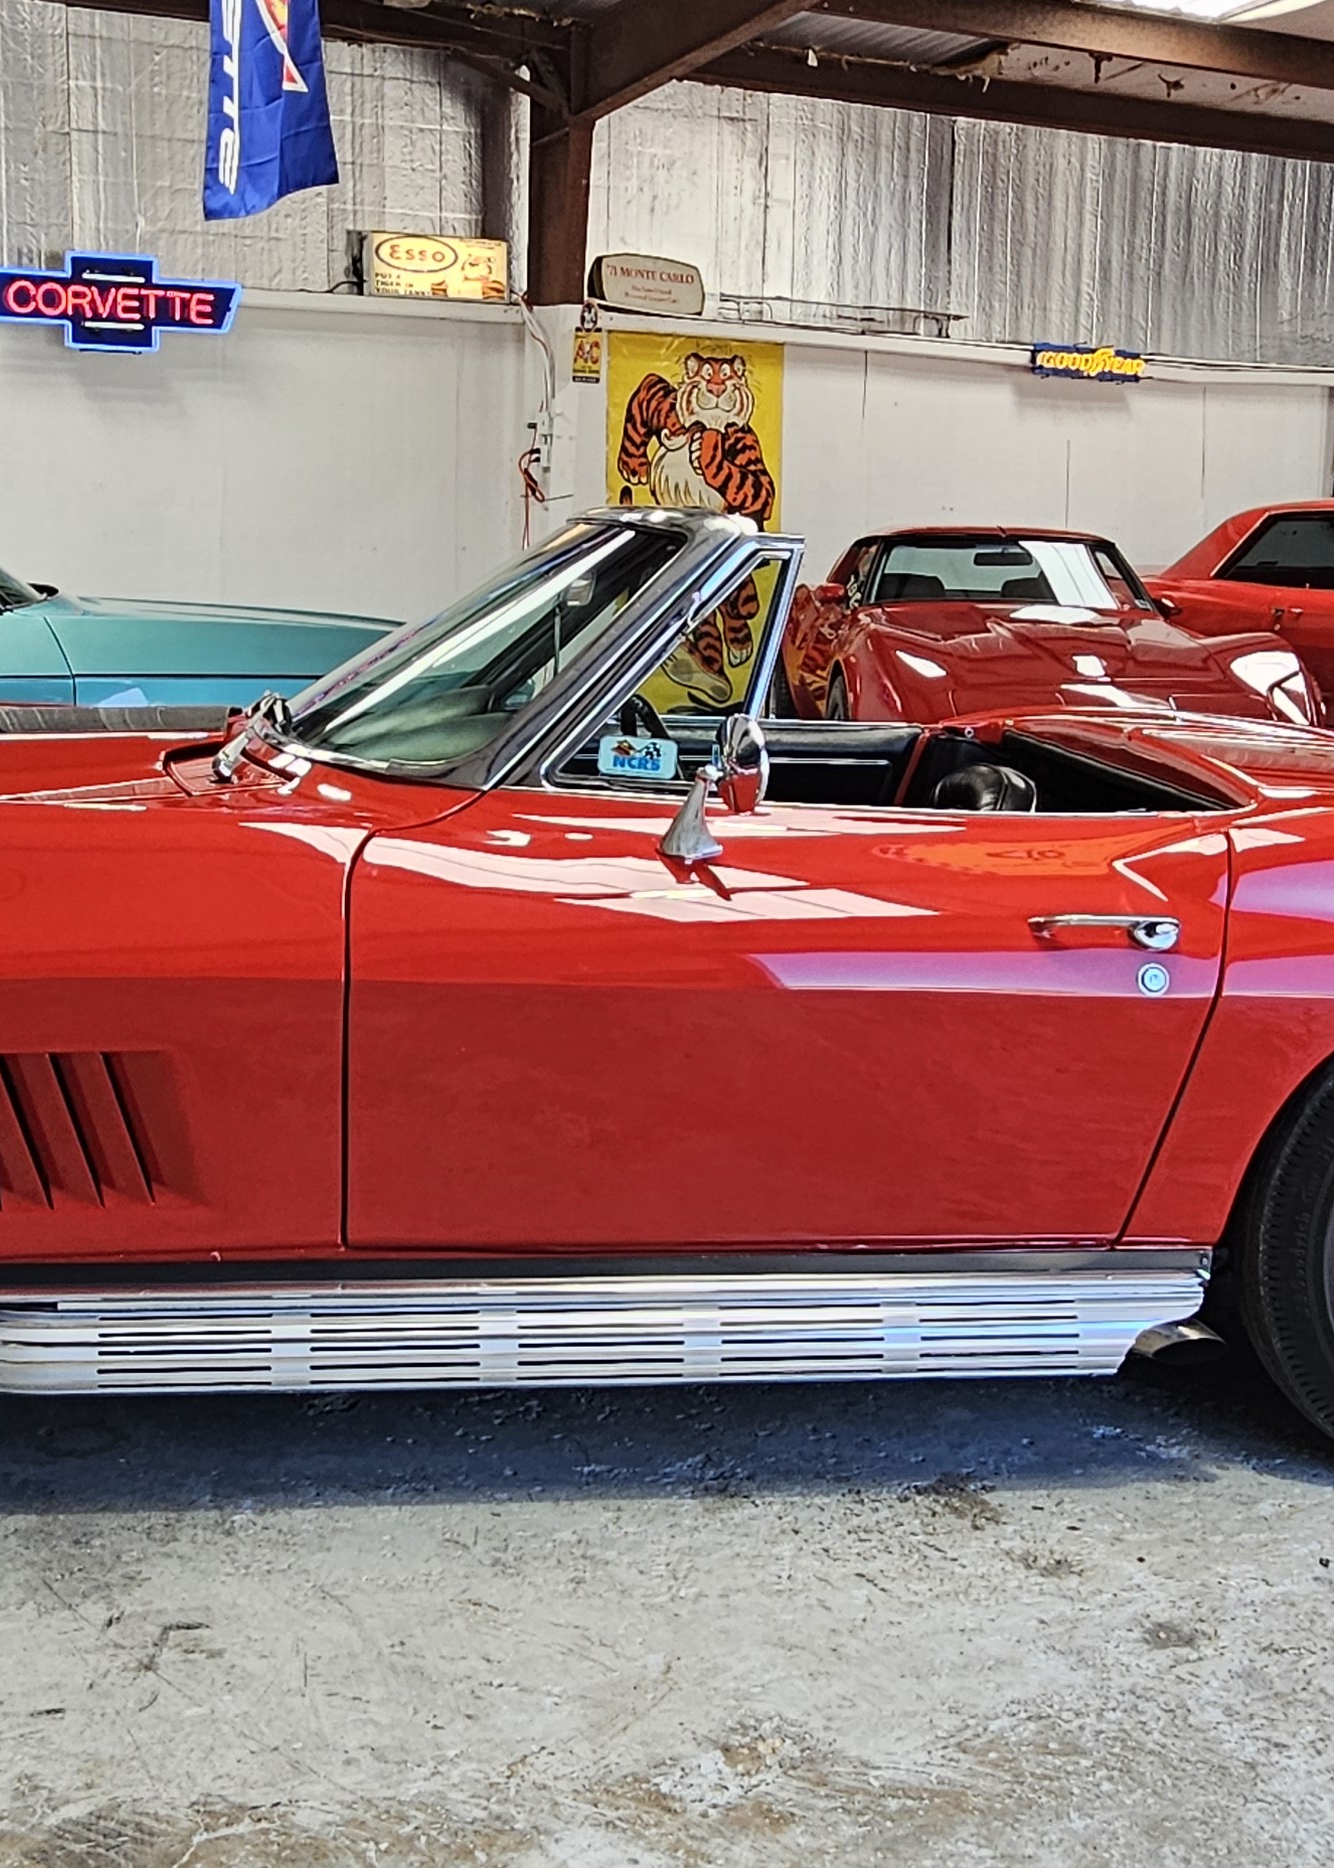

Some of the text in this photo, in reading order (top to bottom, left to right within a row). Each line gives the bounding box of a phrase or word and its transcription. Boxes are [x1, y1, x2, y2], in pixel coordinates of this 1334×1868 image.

[620, 266, 658, 281] MONTE
[660, 271, 695, 285] CARLO
[6, 279, 215, 325] CORVETTE
[613, 755, 661, 771] NCRS
